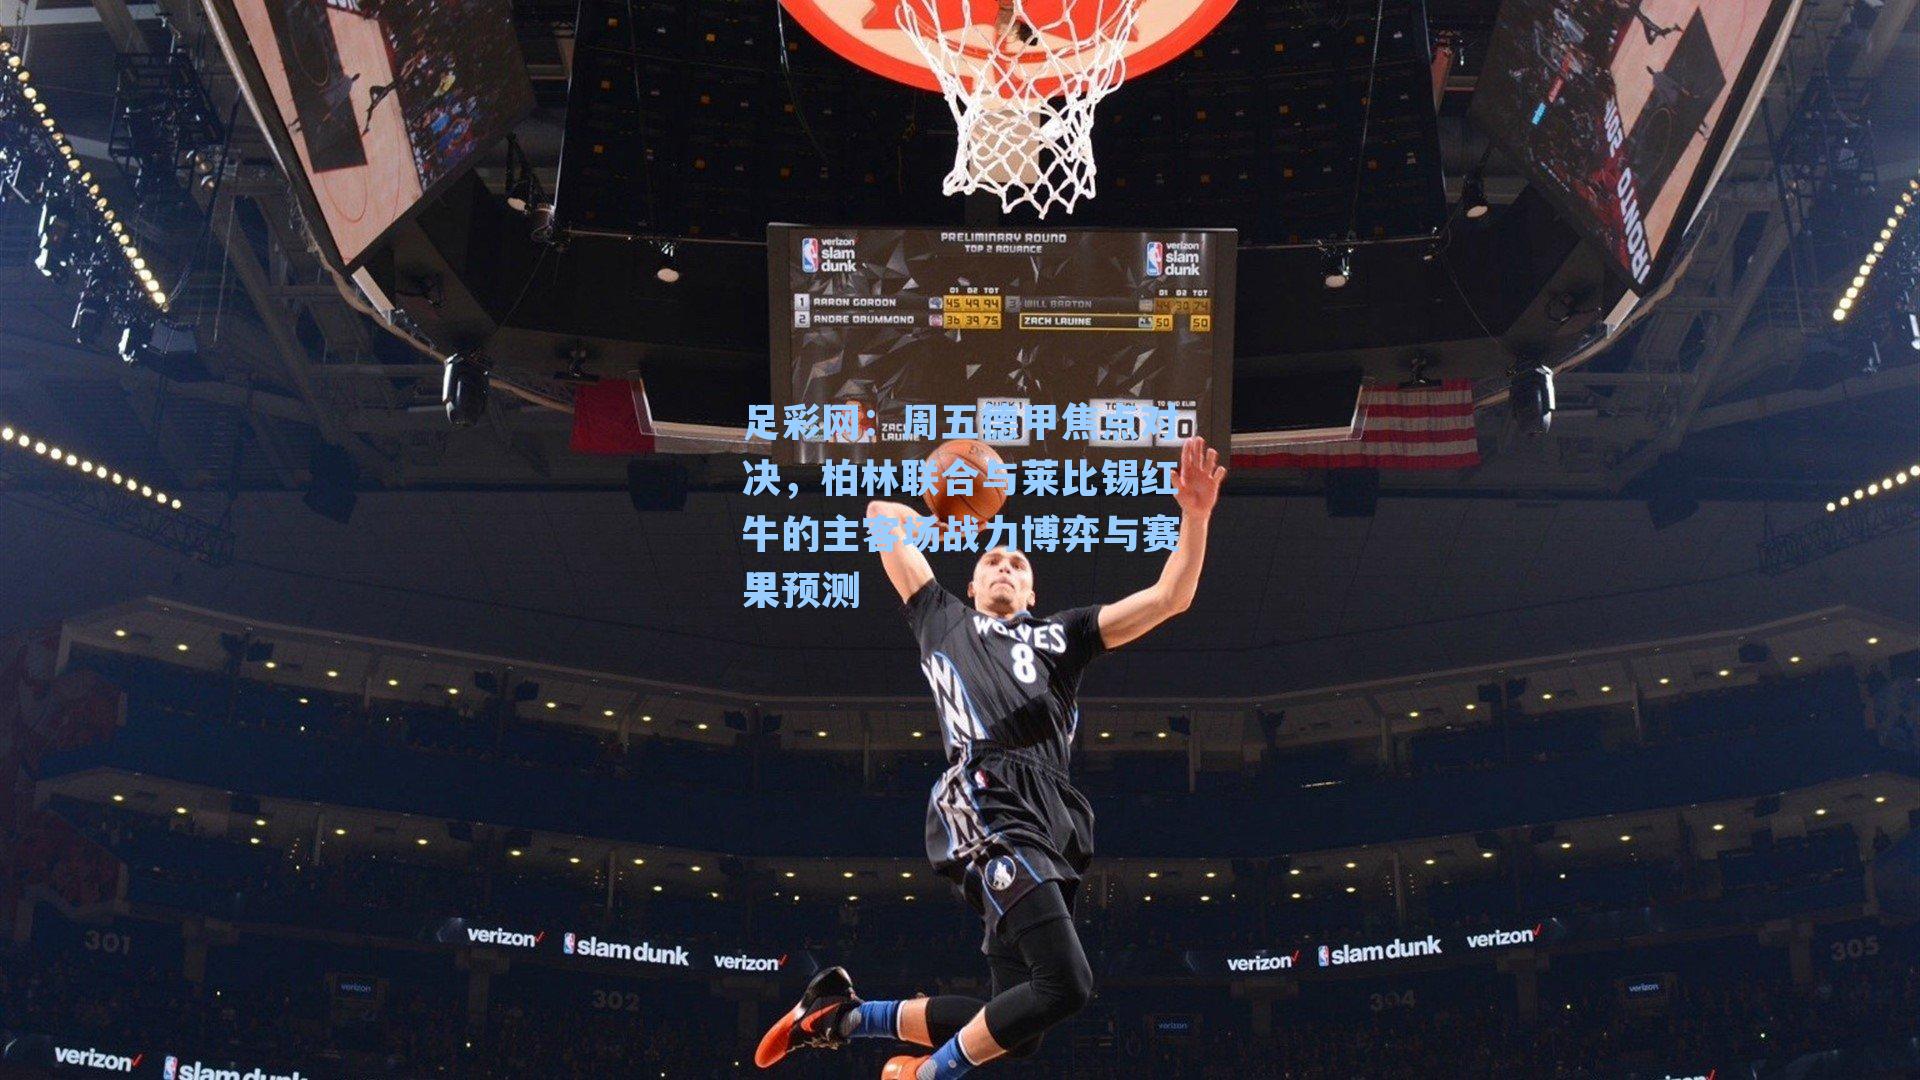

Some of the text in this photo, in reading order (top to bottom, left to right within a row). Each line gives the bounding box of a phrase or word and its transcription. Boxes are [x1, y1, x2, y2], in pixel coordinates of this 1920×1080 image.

[821, 237, 855, 246] verizon
[941, 232, 1067, 243] PRELIMINARY ROUND
[965, 245, 1042, 254] TOP 2 ADVANCE
[1166, 241, 1199, 250] verizon
[821, 246, 855, 259] slam
[1165, 250, 1199, 263] slam
[821, 259, 856, 272] dunk
[1165, 263, 1200, 276] dunk
[799, 297, 999, 308] 1 AARON GORDON 45 49 94
[1024, 300, 1047, 308] WILL
[1050, 300, 1092, 309] BARTON
[799, 315, 999, 325] 2 ANDRE DRUMMOND 36 39 75
[1024, 317, 1208, 328] ZACK LAVINE 50 50
[881, 423, 911, 432] ZAC
[973, 616, 1067, 654] WOLVES
[1011, 643, 1037, 684] 8
[85, 930, 131, 955] 301
[1830, 935, 1879, 961] 305
[467, 928, 779, 971] verizon slam dunk verizon
[1227, 928, 1534, 971] verizon slam dunk verizon
[1628, 982, 1660, 992] verizon
[592, 990, 640, 1011] 302
[55, 1047, 132, 1072] verizon
